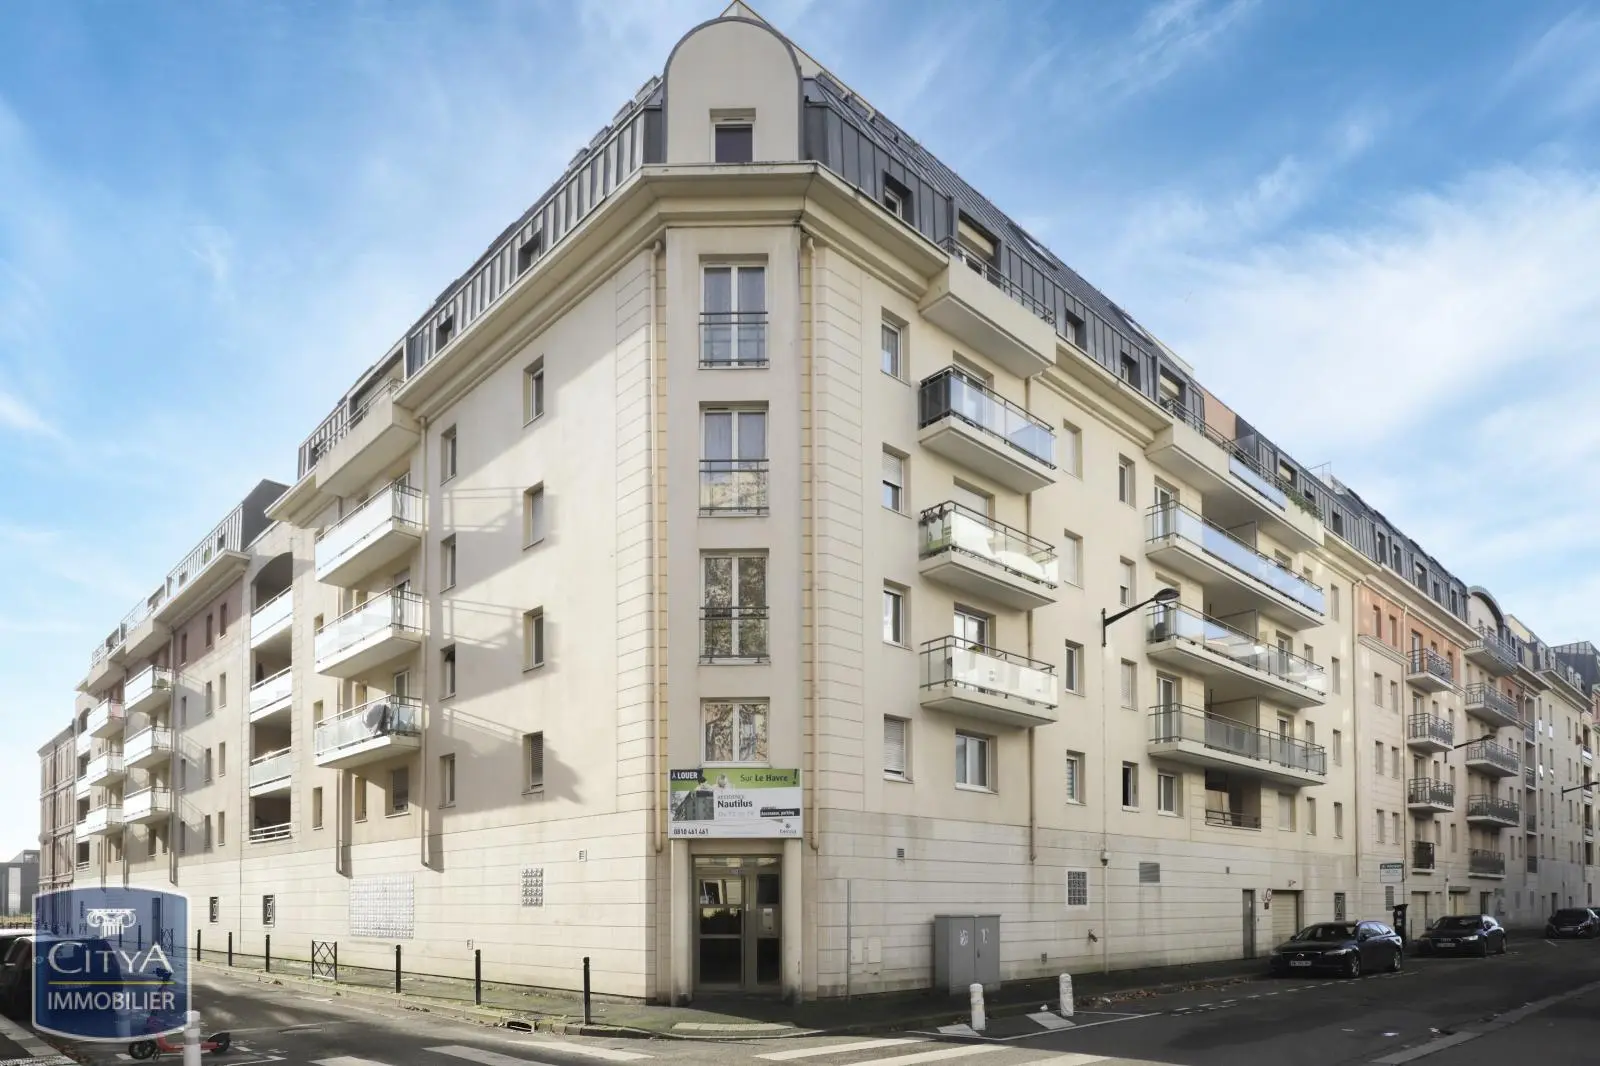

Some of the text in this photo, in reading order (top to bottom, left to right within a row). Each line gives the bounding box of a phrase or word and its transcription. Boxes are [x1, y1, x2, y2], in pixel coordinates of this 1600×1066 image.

[677, 771, 698, 780] LOUER
[740, 774, 753, 782] Sur
[755, 774, 764, 782] Le
[766, 774, 788, 782] Havre
[717, 799, 753, 808] Nautilus
